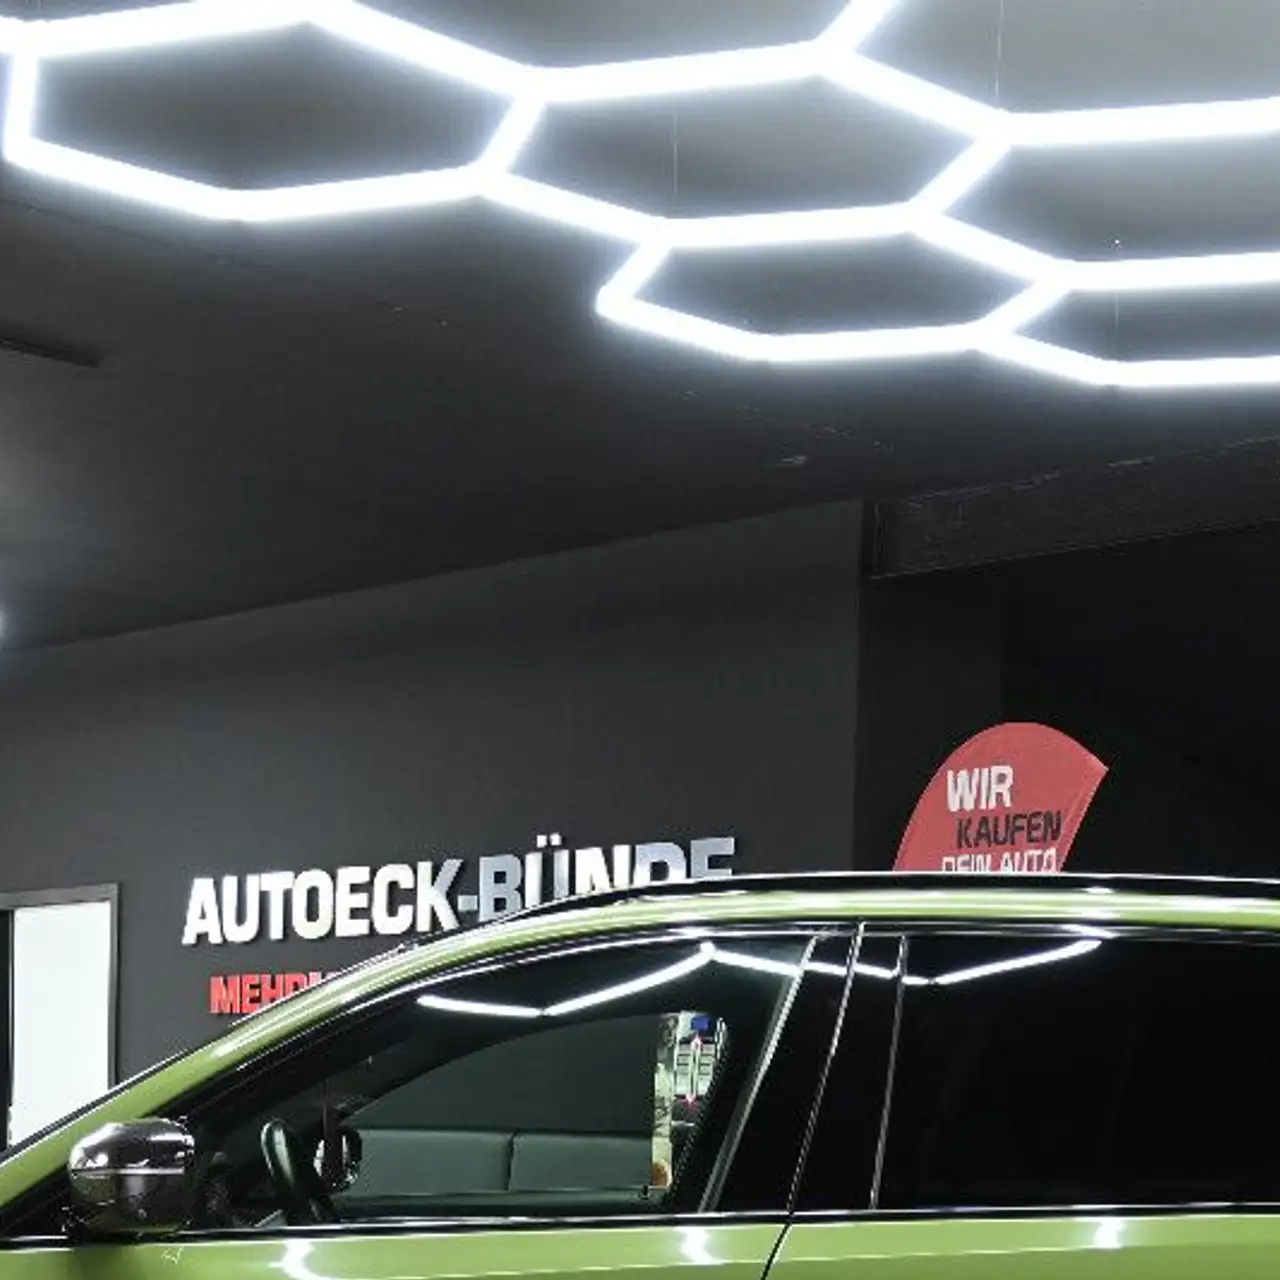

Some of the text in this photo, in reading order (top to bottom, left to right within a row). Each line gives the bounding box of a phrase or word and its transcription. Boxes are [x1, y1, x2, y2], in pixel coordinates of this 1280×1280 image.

[946, 765, 1013, 812] WIR
[956, 810, 1062, 849] KAUFEN
[998, 847, 1058, 873] AUTO
[181, 834, 736, 945] AUTOECK-BÜNDE
